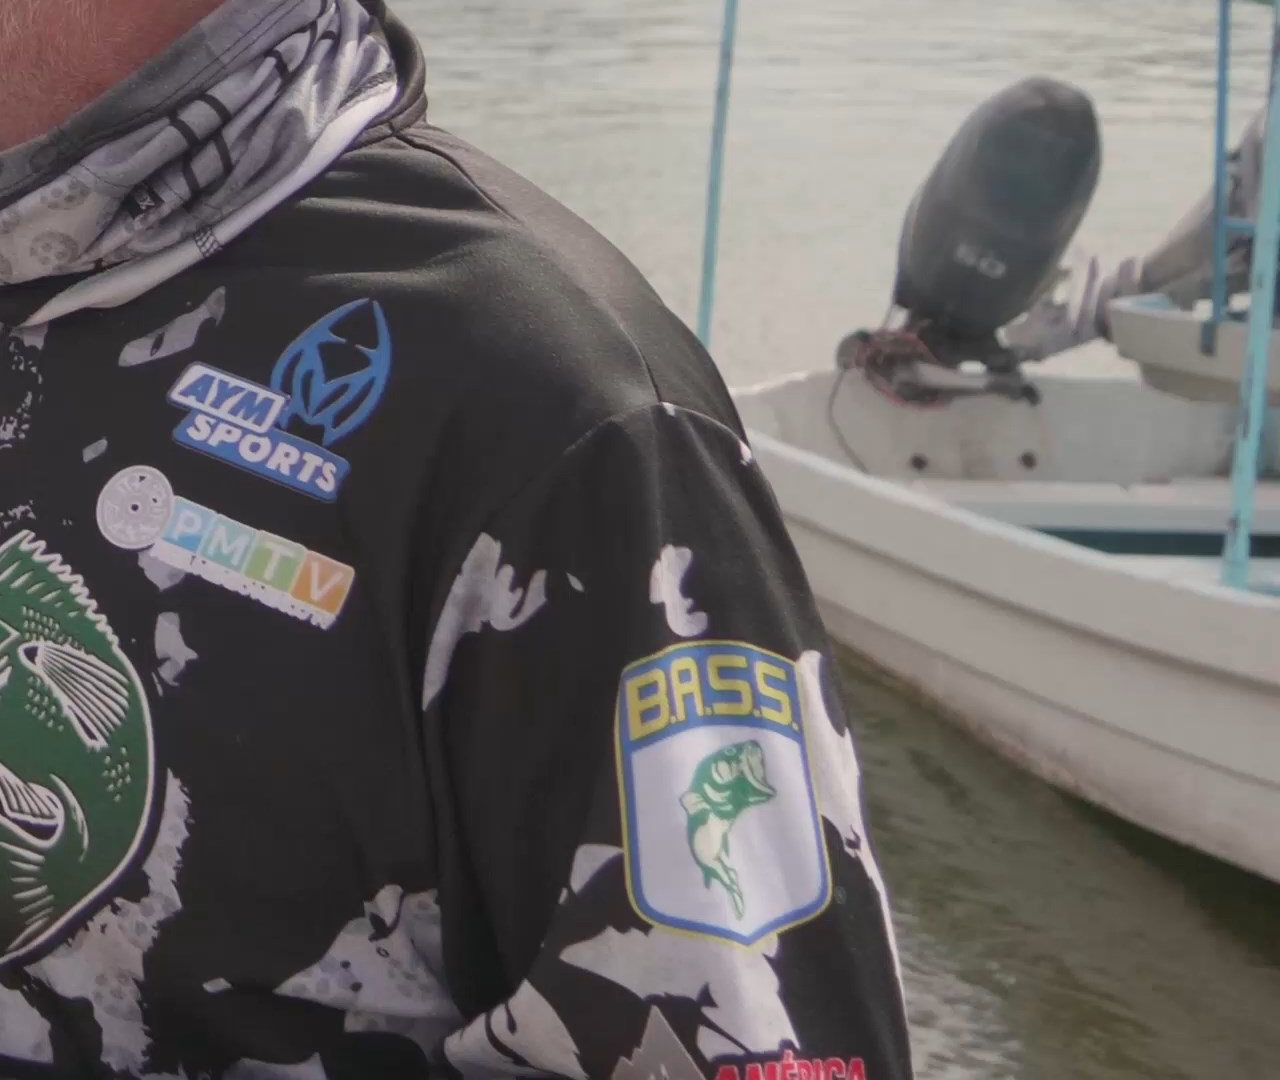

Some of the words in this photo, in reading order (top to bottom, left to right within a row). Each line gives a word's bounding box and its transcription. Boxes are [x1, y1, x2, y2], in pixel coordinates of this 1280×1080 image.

[180, 373, 277, 428] AYM
[186, 413, 338, 493] SPORTS
[172, 510, 345, 603] PMTV
